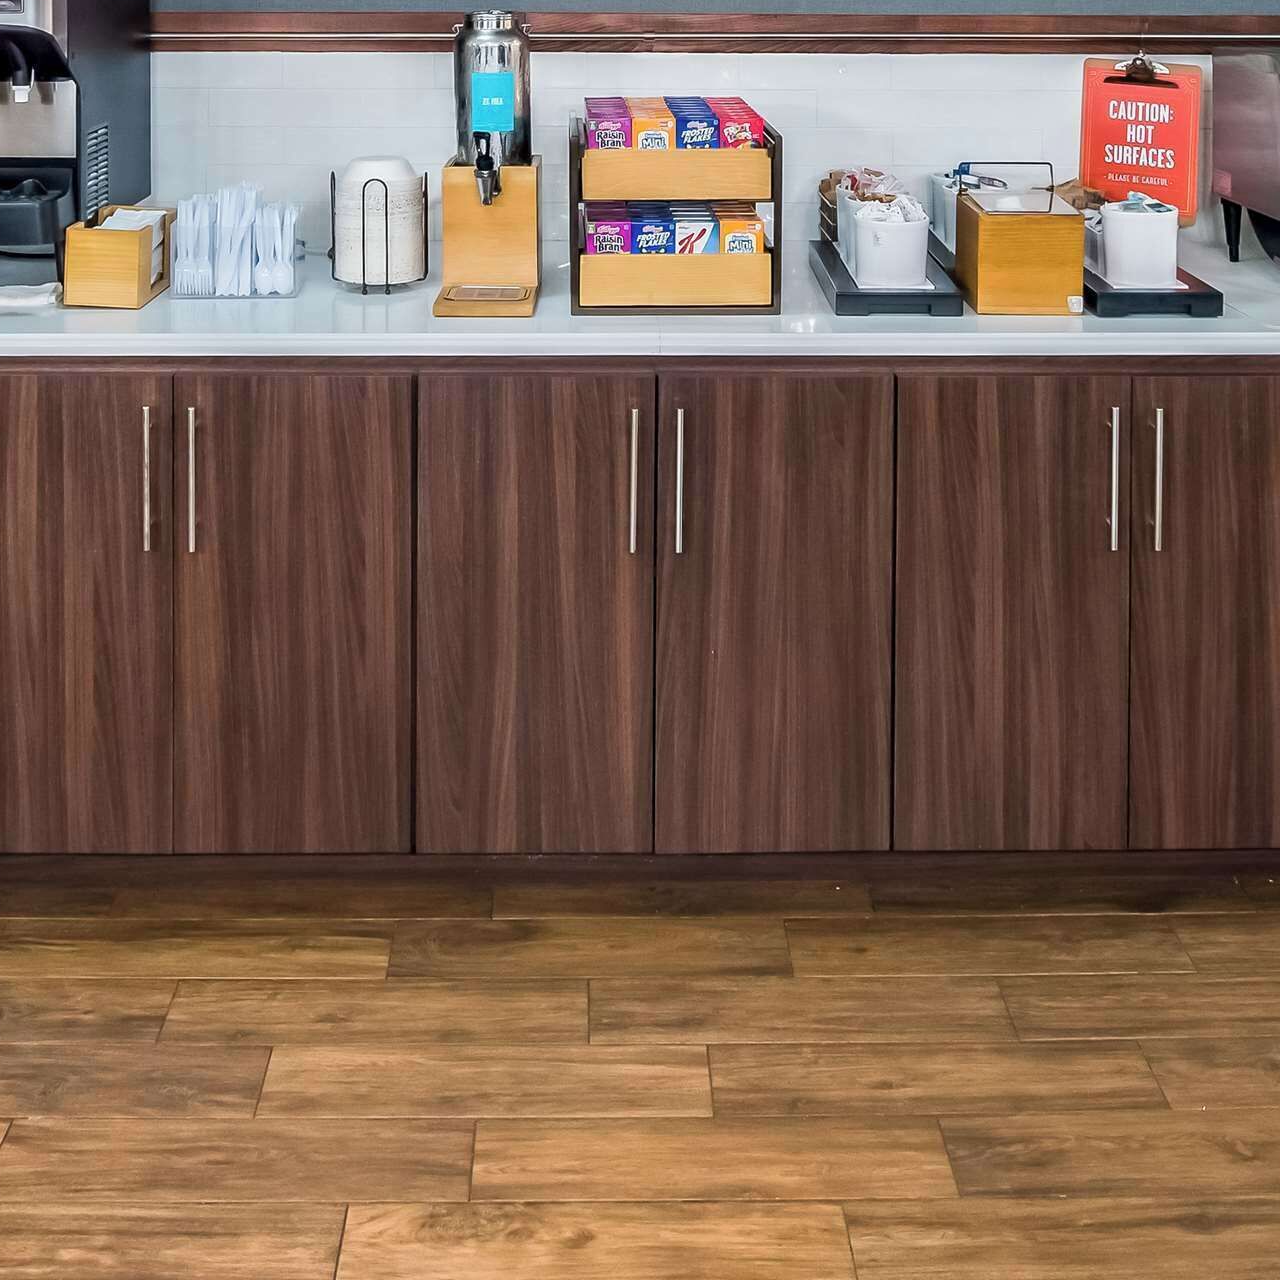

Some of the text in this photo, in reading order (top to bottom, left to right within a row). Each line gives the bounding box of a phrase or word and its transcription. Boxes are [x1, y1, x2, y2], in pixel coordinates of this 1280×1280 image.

[1108, 100, 1175, 124] CAUTION:
[596, 131, 624, 140] Raisin
[681, 127, 714, 138] FROSTED
[1126, 123, 1155, 144] HOT
[600, 140, 623, 148] Bran
[683, 133, 711, 144] FLAKES
[1104, 144, 1176, 169] SURFACES
[1107, 172, 1130, 182] PLEASE
[1141, 176, 1169, 186] CAREFUL
[594, 235, 623, 244] Raisin
[637, 232, 670, 242] FROSTED
[598, 243, 621, 252] Bran
[729, 239, 753, 251] Mini
